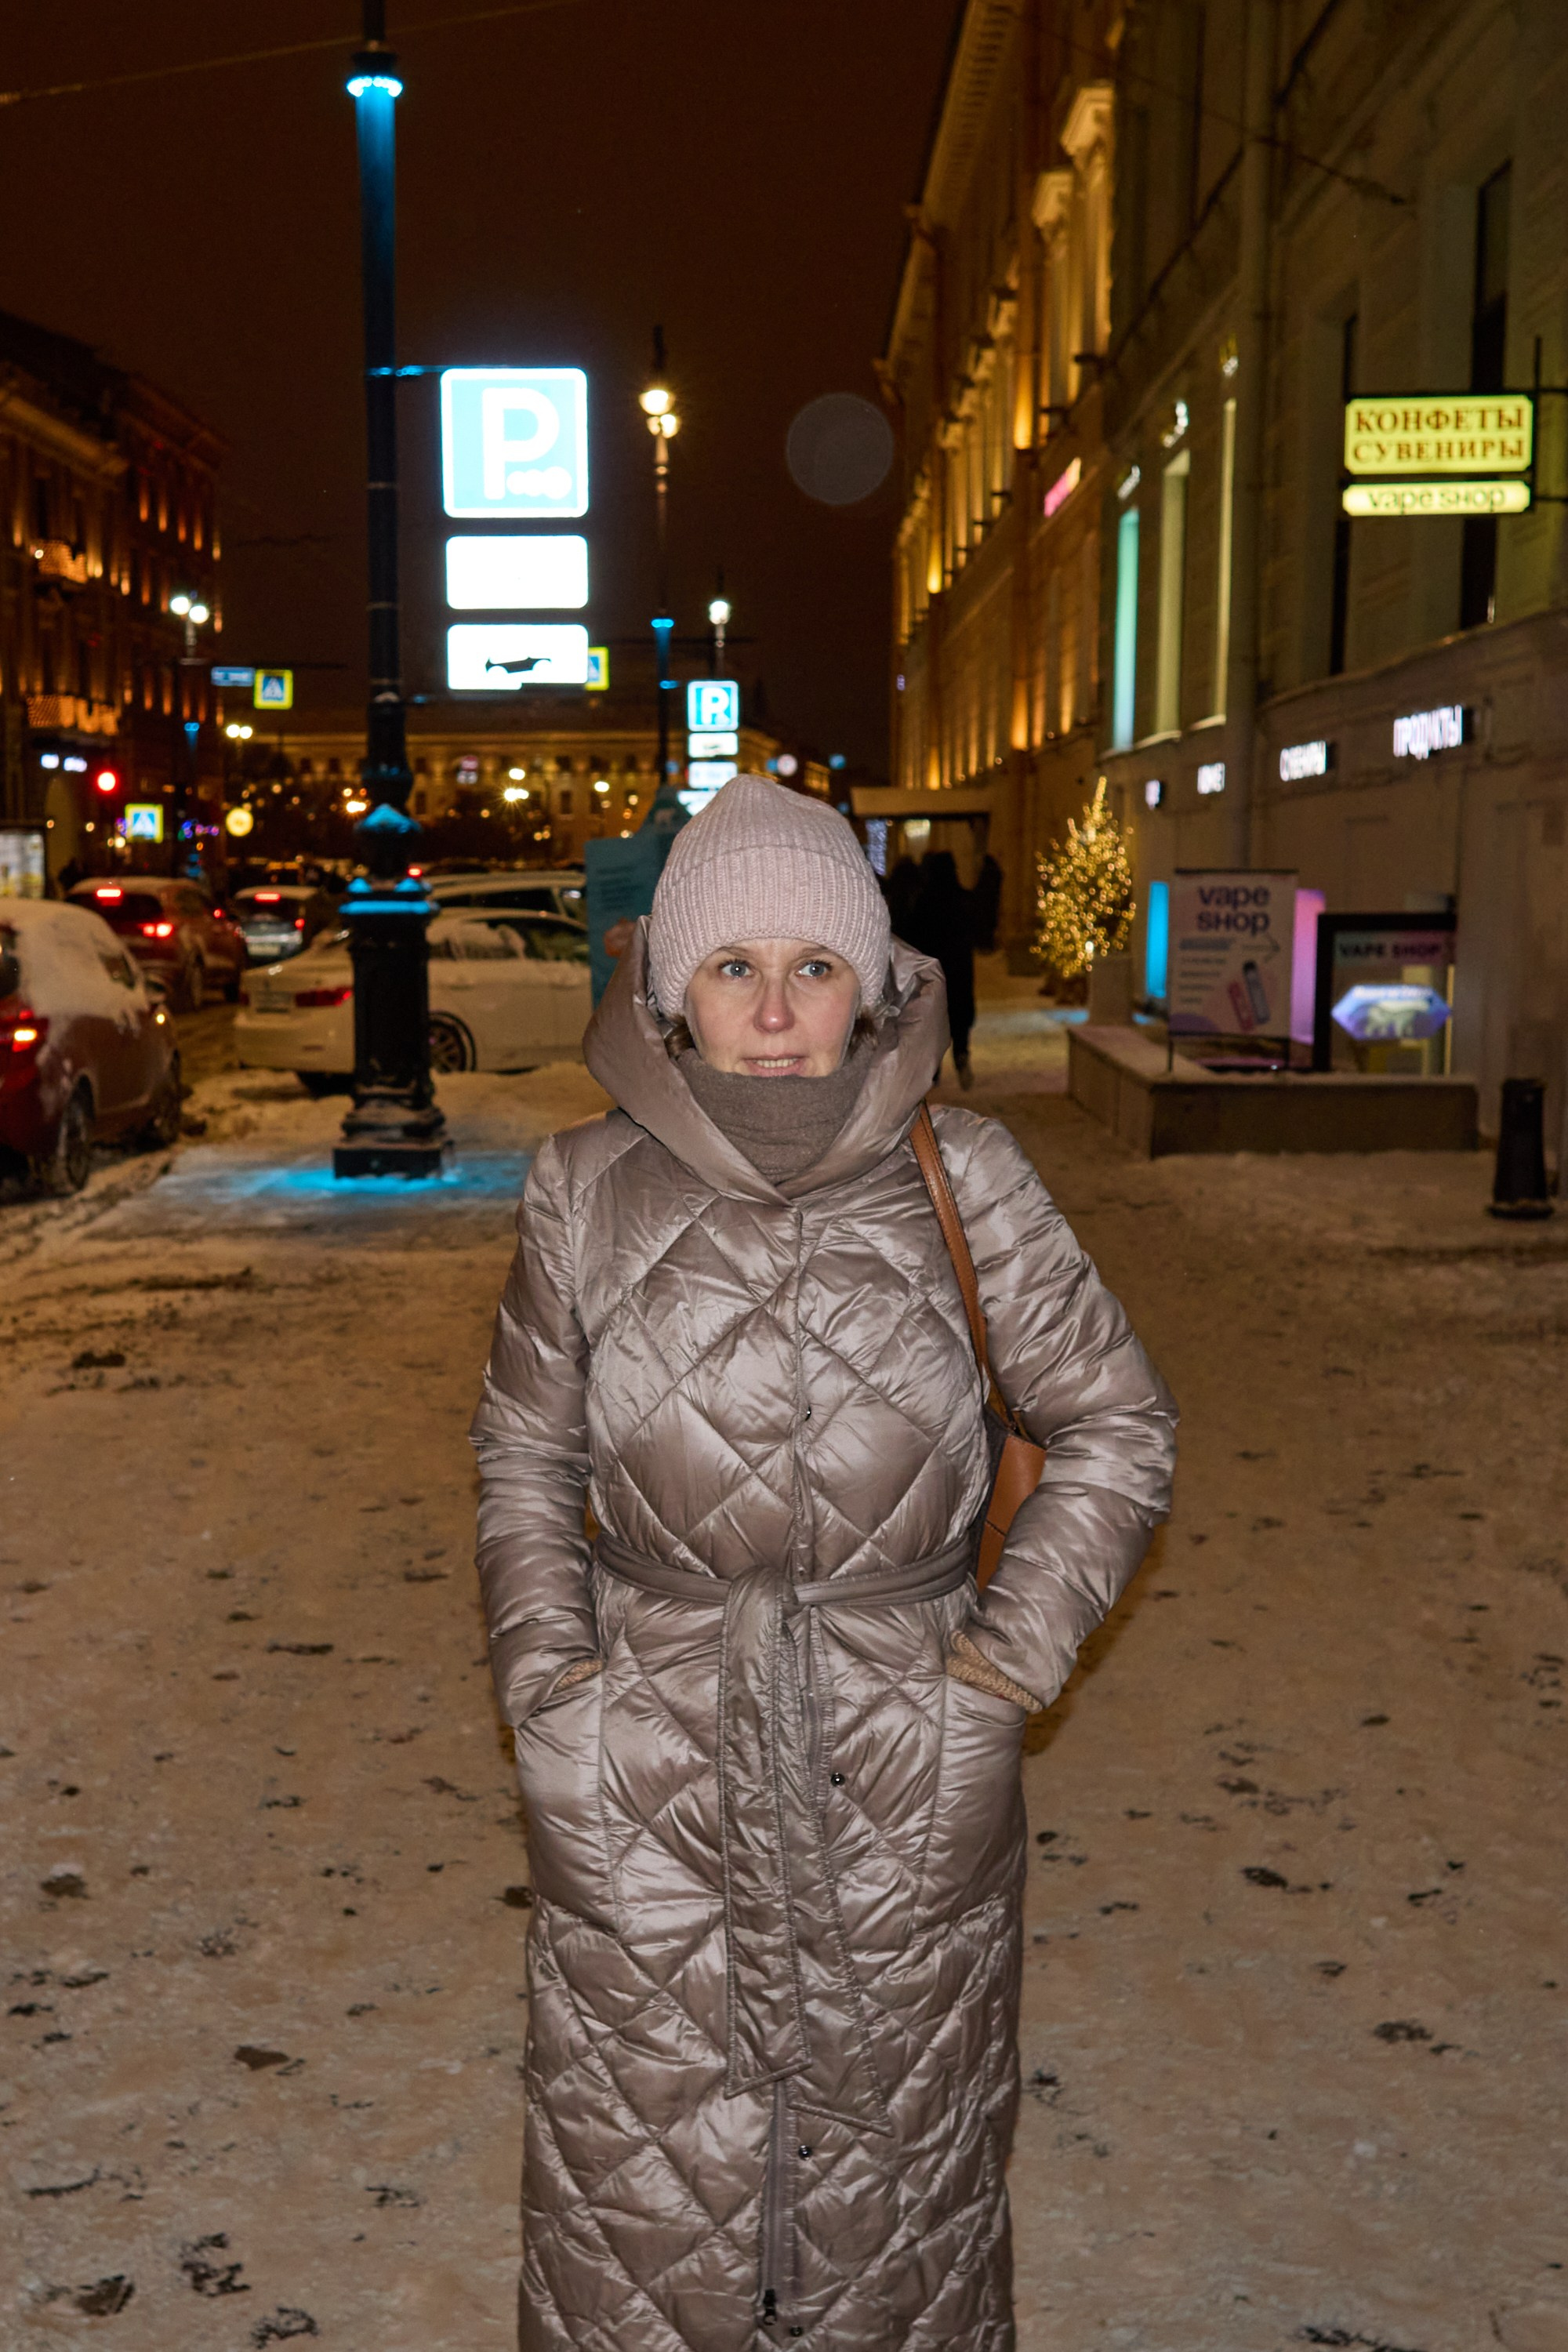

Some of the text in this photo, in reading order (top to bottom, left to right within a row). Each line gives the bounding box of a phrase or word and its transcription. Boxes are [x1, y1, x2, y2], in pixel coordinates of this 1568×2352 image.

[1356, 407, 1525, 433] КОНФЕТЫ
[481, 387, 561, 500] P
[1354, 439, 1523, 462] СУВЕНИРЫ
[1368, 489, 1433, 515] vape
[1198, 884, 1271, 909] vape
[1339, 942, 1443, 957] VAPE SHOP
